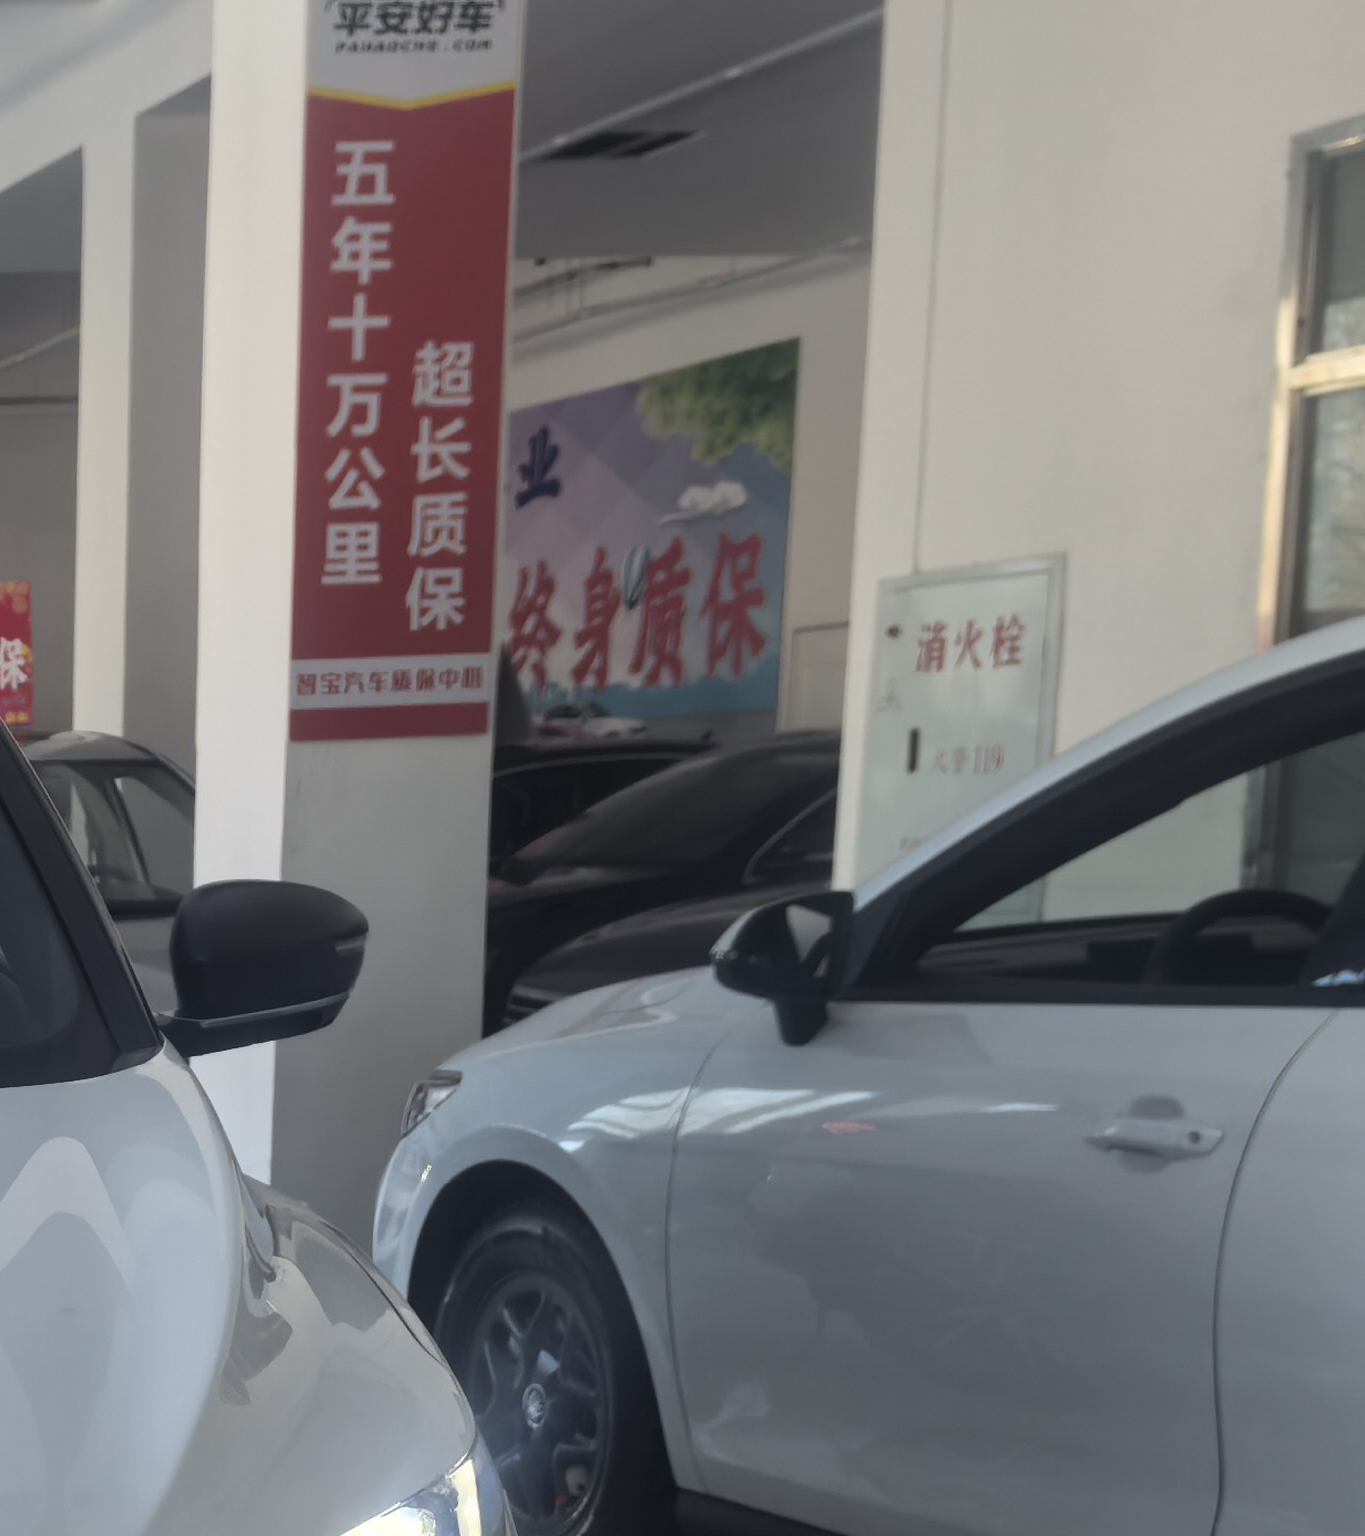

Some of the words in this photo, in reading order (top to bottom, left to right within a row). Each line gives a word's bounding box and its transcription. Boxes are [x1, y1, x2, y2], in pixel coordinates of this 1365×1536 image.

[333, 1, 495, 35] 平安好车
[320, 138, 397, 587] 五年十万公里
[405, 340, 475, 633] 超长质保
[515, 425, 562, 510] 业
[508, 533, 768, 692] 终身质保
[916, 614, 1025, 672] 消火栓
